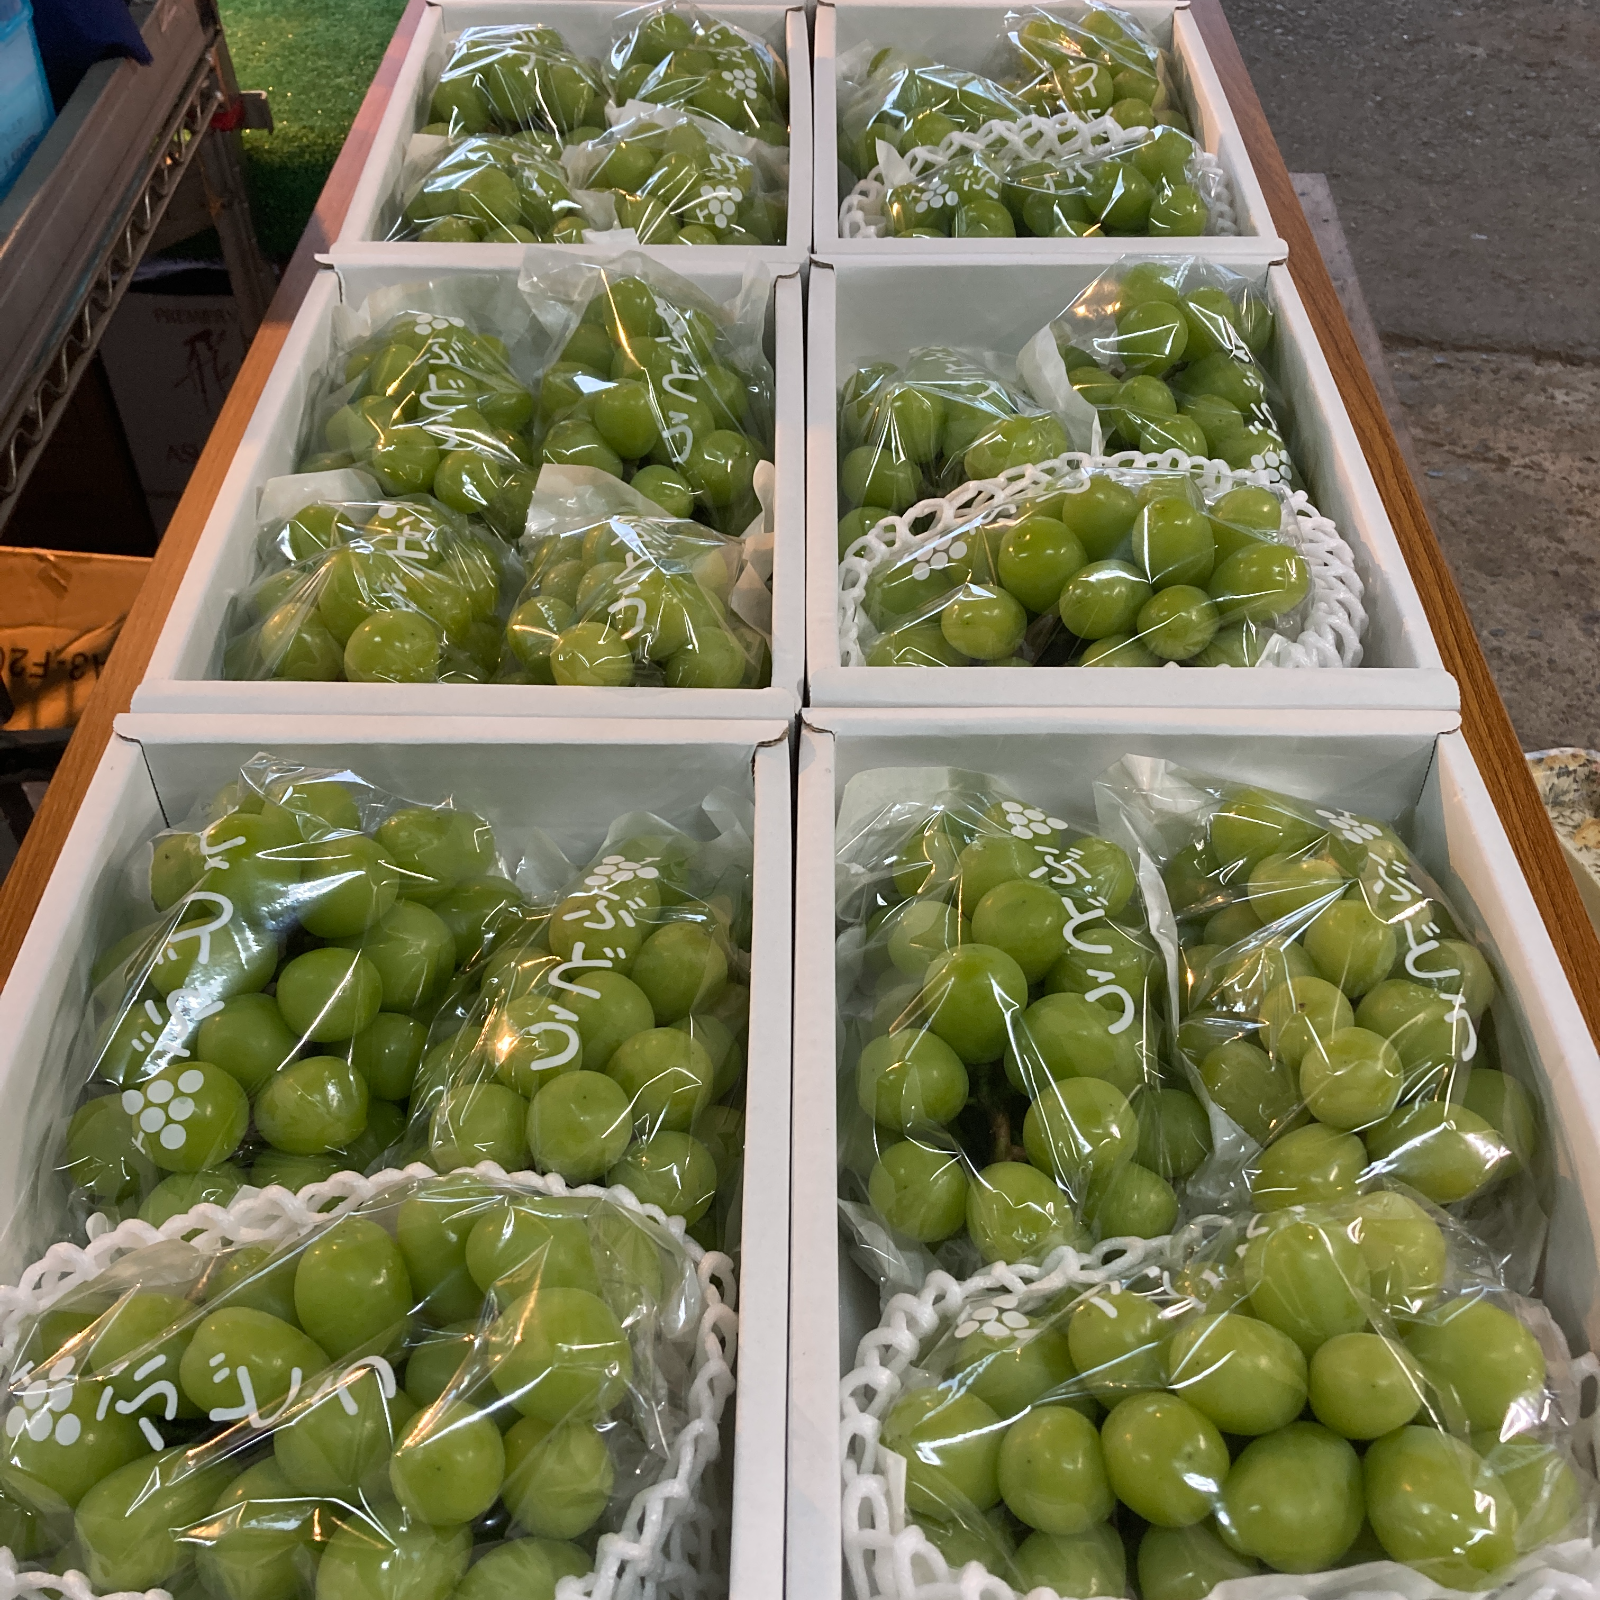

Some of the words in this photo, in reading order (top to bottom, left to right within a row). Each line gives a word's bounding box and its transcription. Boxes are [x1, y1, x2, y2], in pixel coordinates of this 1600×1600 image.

[529, 886, 646, 1071] ぶどう
[1029, 845, 1134, 1034] ぶどう
[1365, 851, 1478, 1062] ぶどう
[95, 1351, 397, 1452] ぶどう
